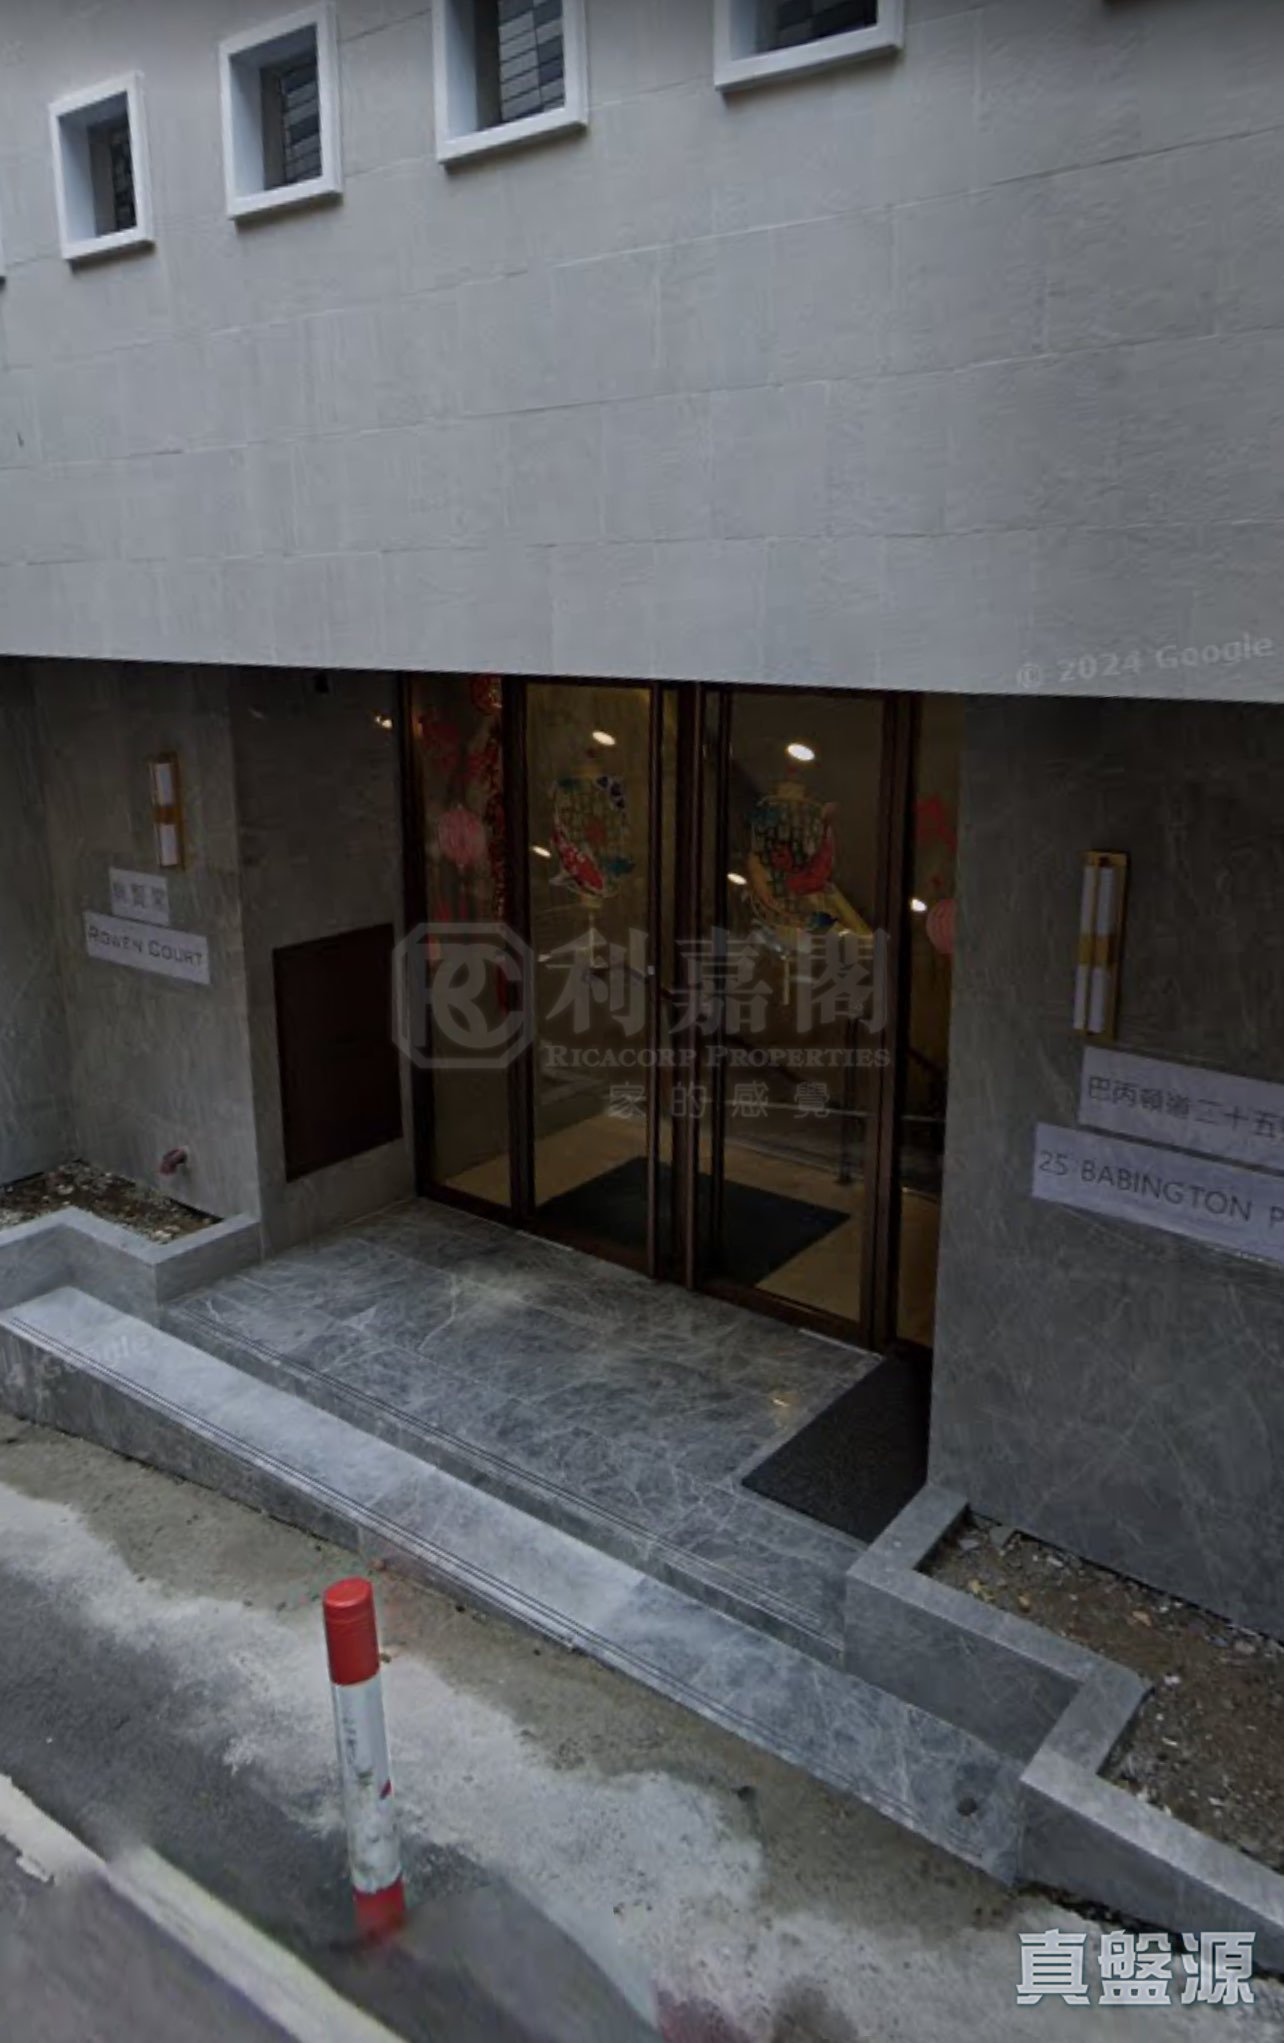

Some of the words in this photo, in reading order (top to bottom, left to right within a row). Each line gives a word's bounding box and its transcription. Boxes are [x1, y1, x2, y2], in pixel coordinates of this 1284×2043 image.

[148, 939, 203, 966] COURT
[1088, 1075, 1284, 1140] 巴丙頓道二十五
[1038, 1150, 1069, 1178] 25
[1081, 1159, 1252, 1222] BABINGTON
